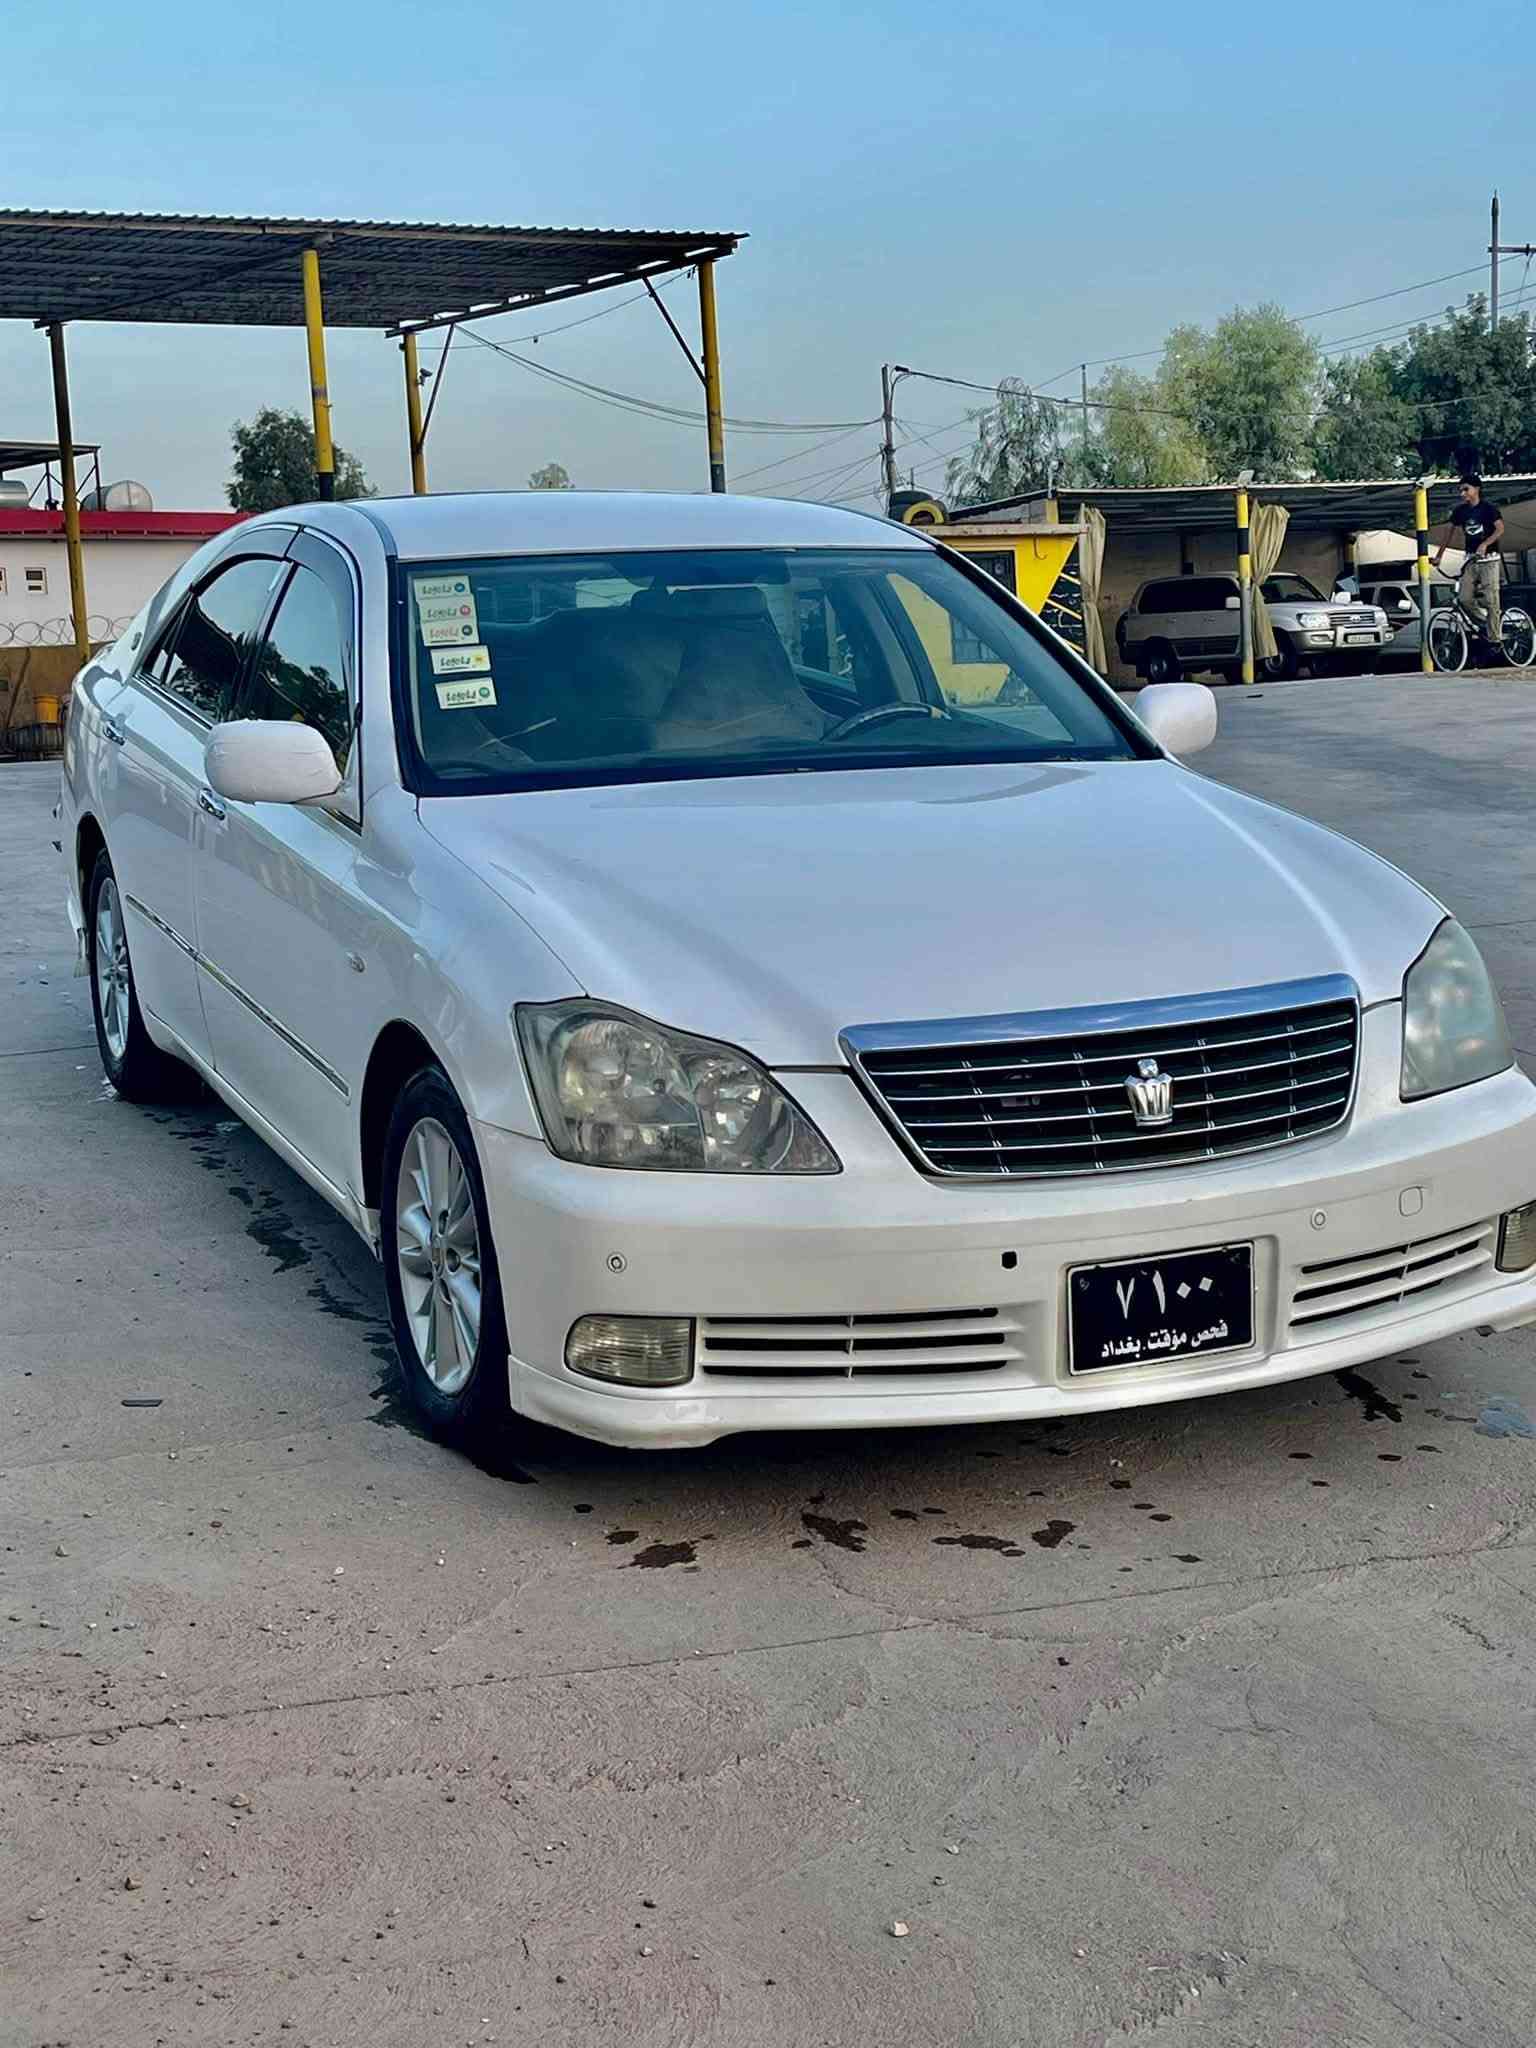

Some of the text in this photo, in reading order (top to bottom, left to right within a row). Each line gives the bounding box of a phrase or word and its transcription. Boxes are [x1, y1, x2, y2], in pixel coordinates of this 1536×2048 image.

[1116, 1270, 1213, 1319] ٧١٠٠
[1191, 1319, 1228, 1346] فحص
[1101, 1336, 1141, 1358] بغداد
